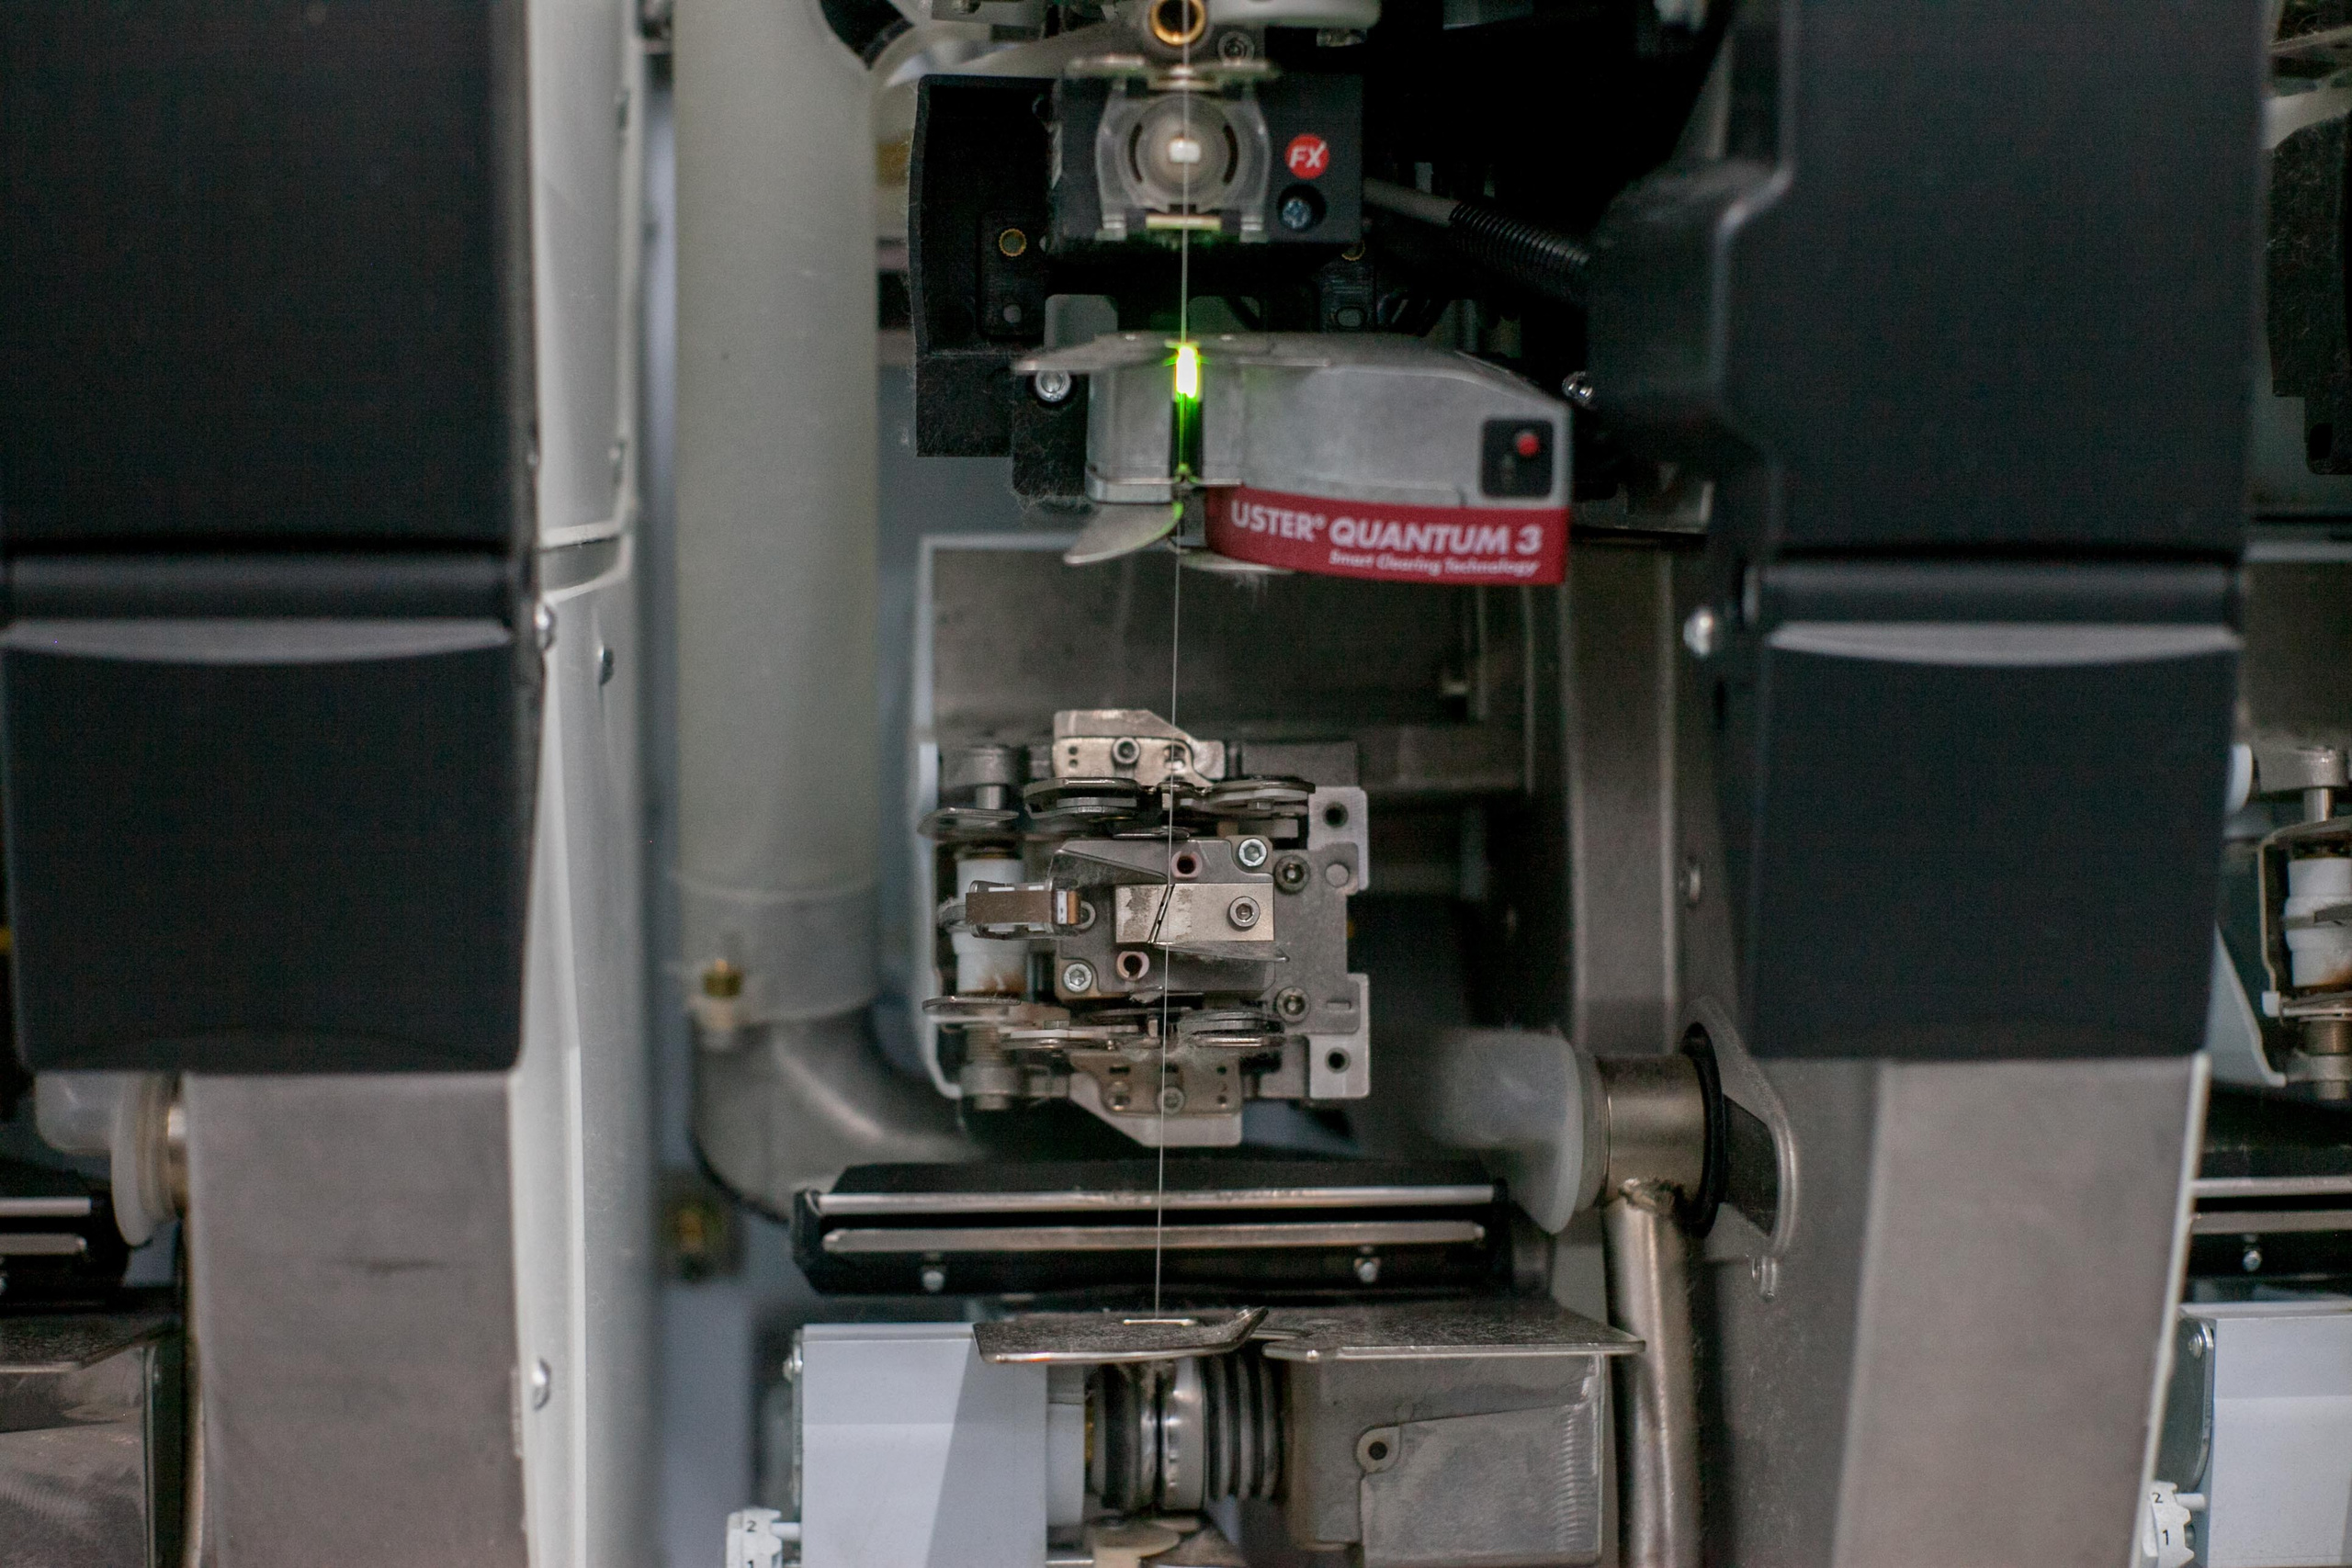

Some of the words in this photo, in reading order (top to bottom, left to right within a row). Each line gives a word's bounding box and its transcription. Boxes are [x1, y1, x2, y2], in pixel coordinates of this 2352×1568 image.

[1289, 141, 1326, 168] FX
[1329, 517, 1510, 553] QUANTUM
[1516, 525, 1543, 555] 3
[1329, 551, 1374, 567] Smart
[1444, 558, 1539, 577] Technology
[2152, 1492, 2164, 1504] 2
[746, 1520, 757, 1533] 2
[2162, 1529, 2169, 1546] 1
